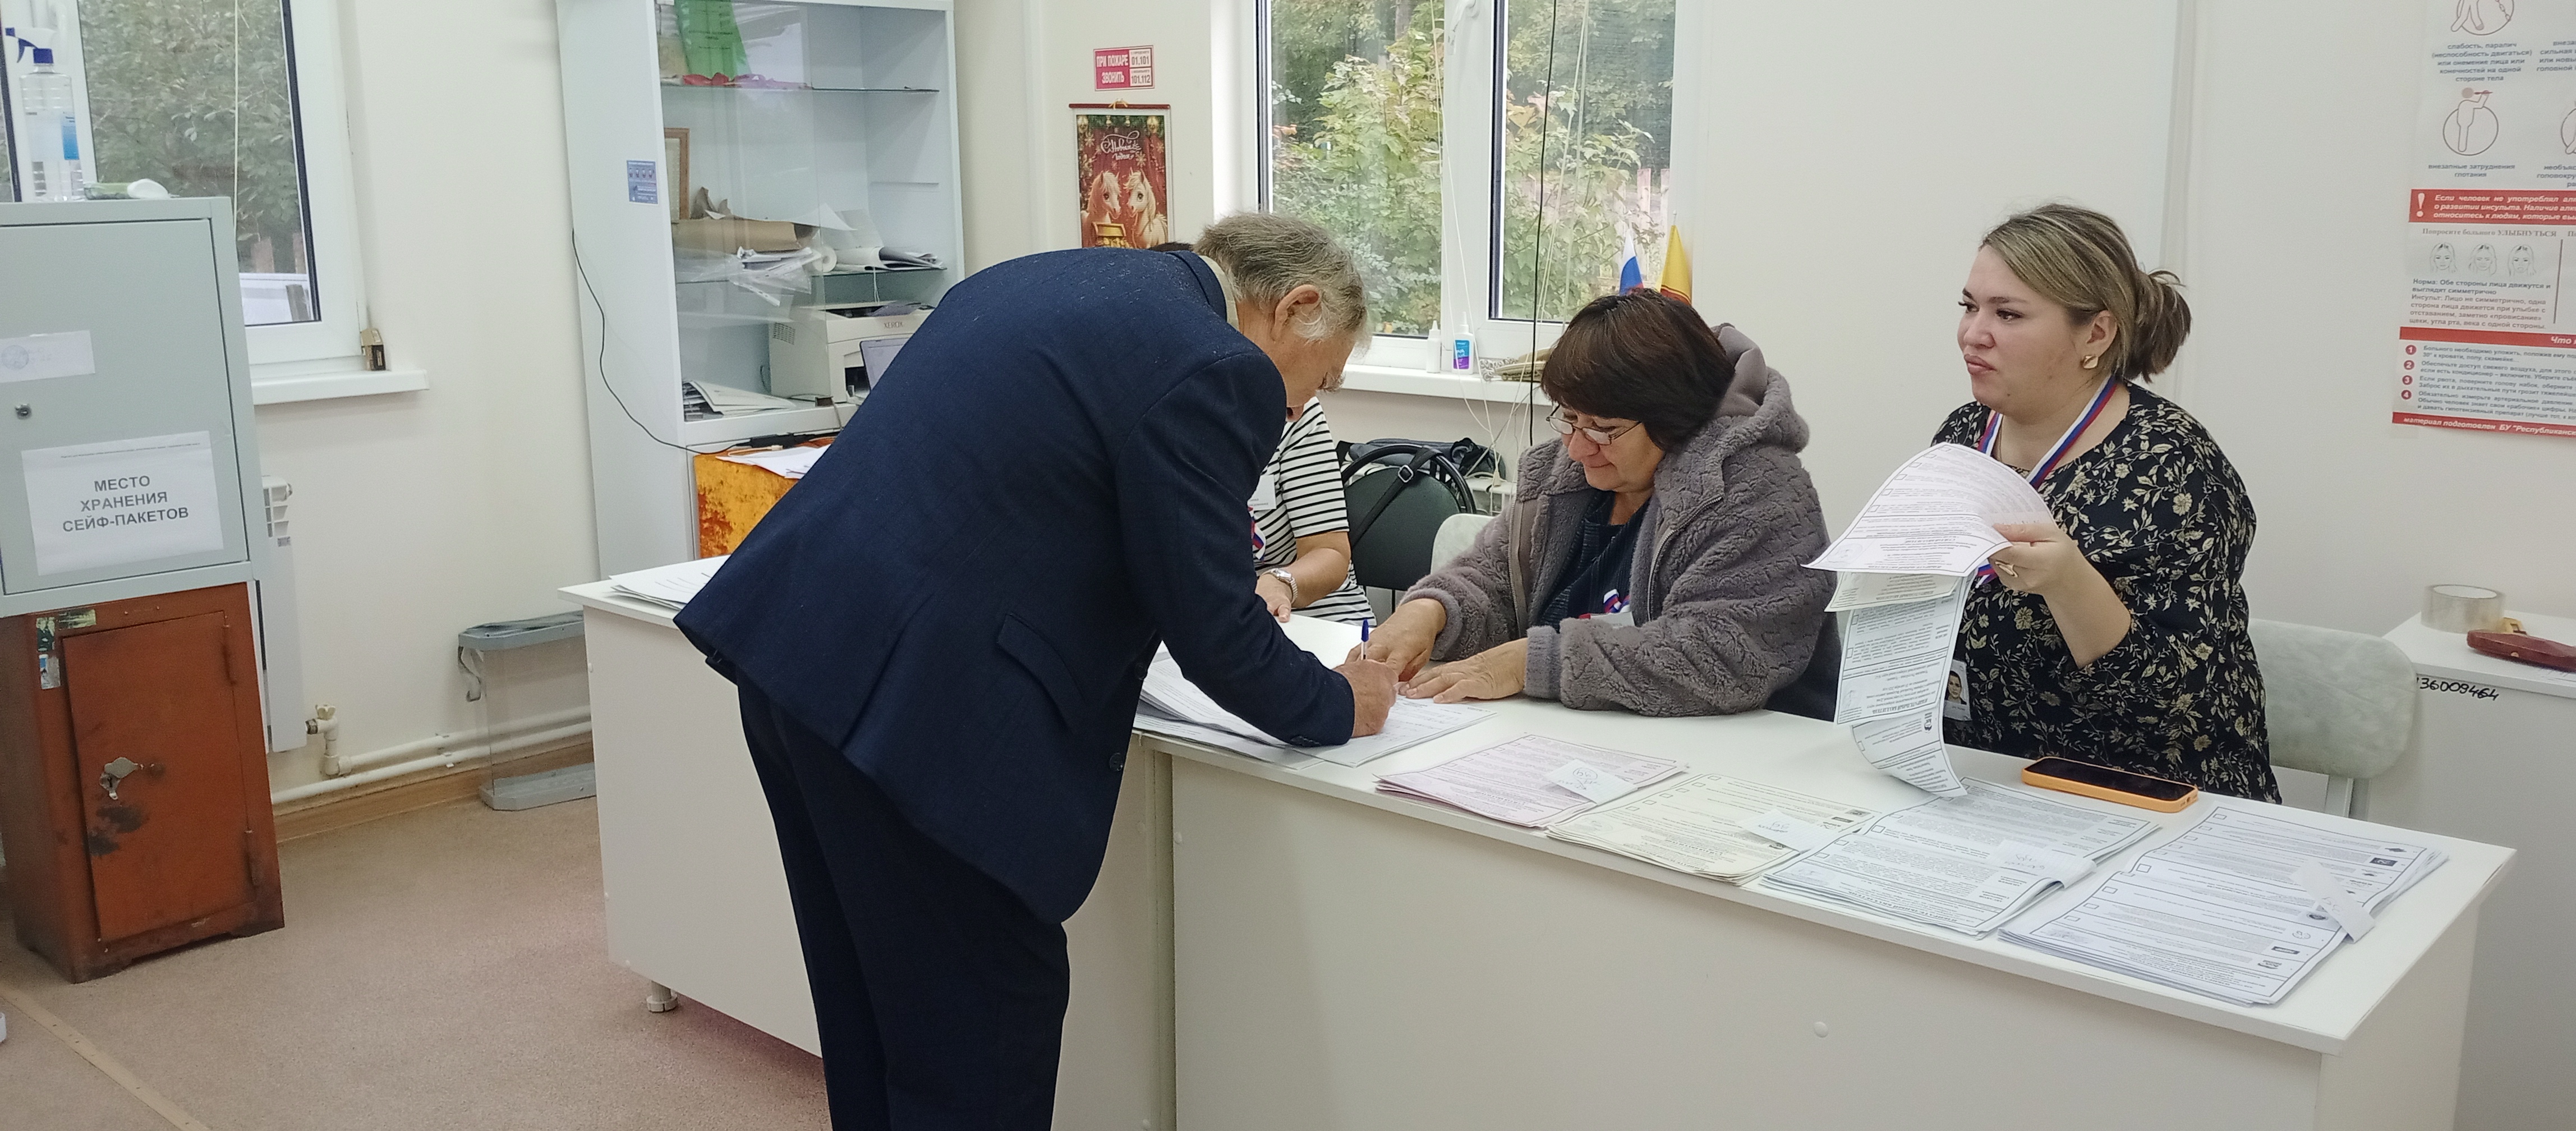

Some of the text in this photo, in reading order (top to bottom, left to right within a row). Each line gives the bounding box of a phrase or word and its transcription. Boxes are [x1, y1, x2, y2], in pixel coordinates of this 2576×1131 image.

[1096, 54, 1129, 67] ПРИ ПОЖАРЕ
[1102, 71, 1125, 84] ЗВОНИТЬ
[2551, 336, 2572, 344] Что
[2442, 420, 2496, 430] подготовлен
[94, 476, 150, 492] МЕСТО
[80, 491, 168, 512] ХРАНЕНИЯ
[63, 507, 189, 532] СЕЙФ-ПАКЕТОВ
